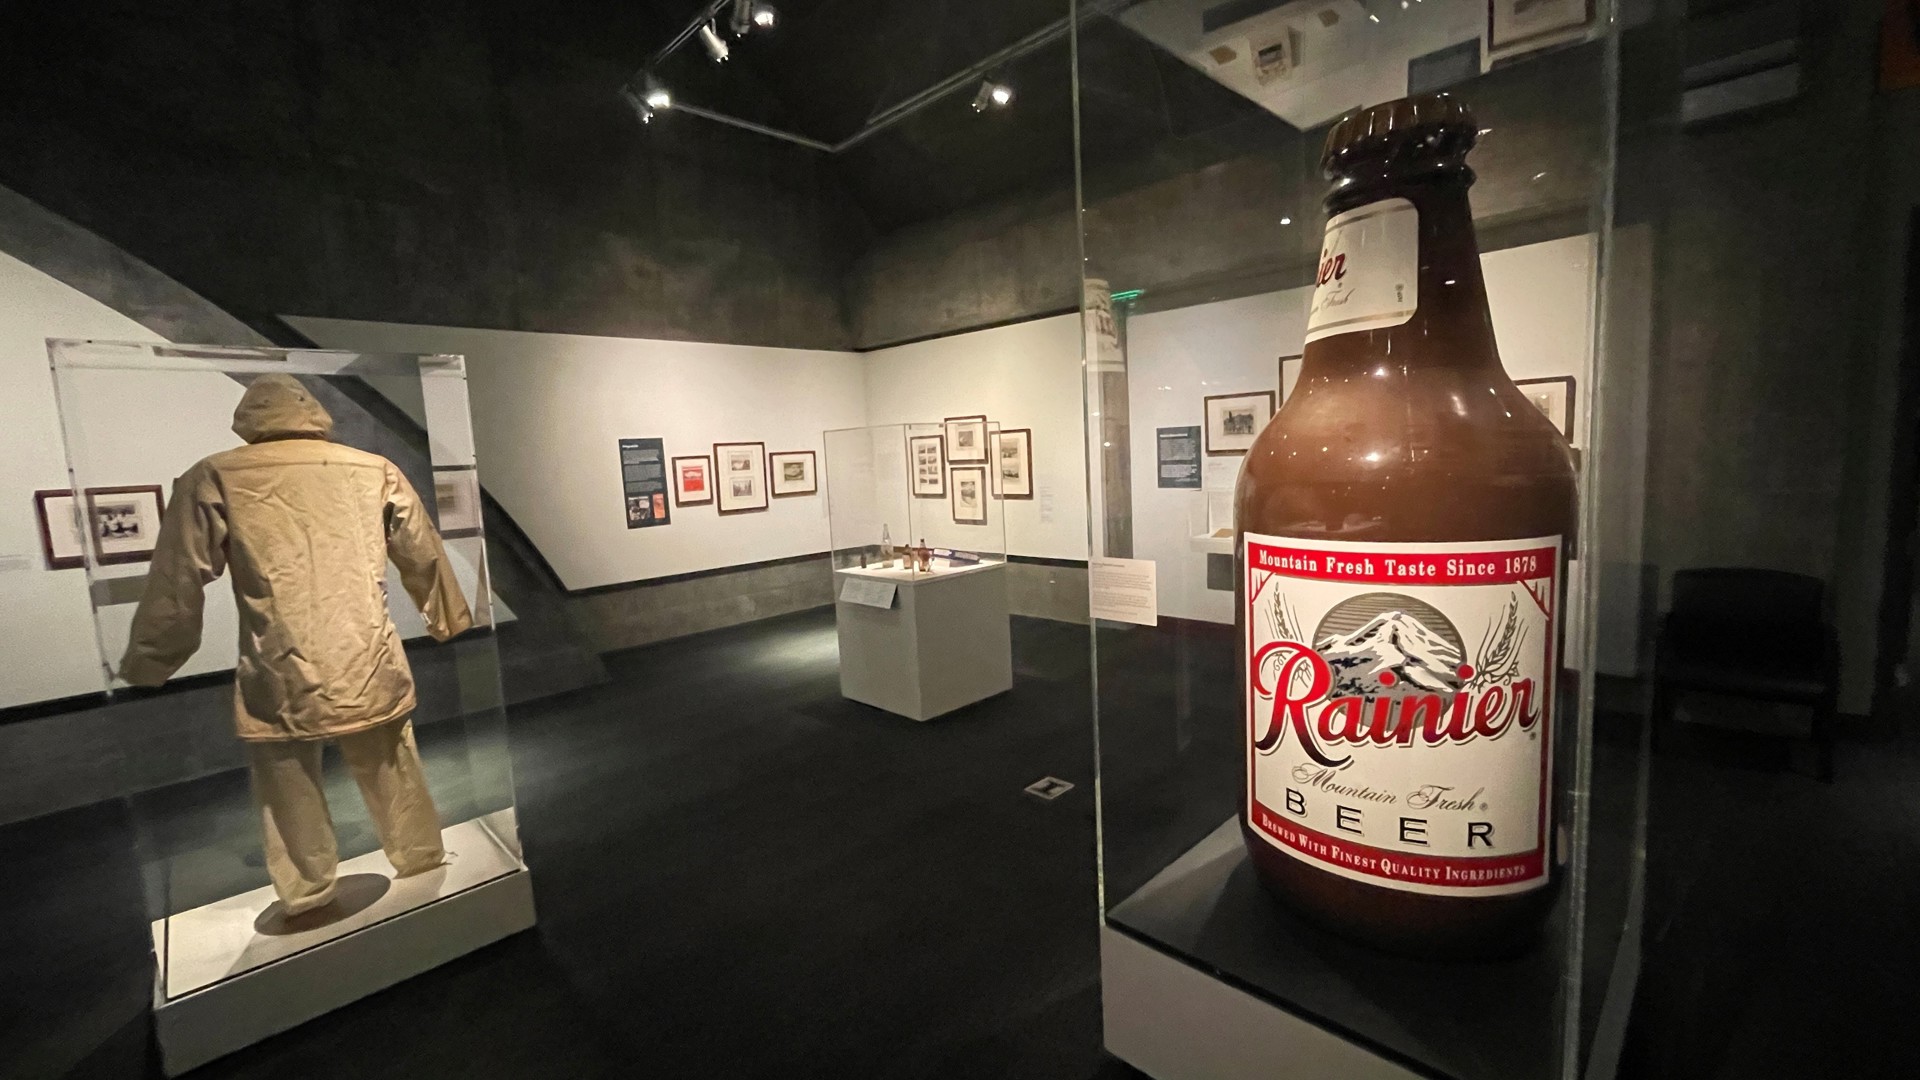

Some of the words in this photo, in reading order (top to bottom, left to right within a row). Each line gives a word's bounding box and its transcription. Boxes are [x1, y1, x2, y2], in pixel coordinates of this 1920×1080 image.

[1259, 549, 1317, 571] Mountain
[1326, 556, 1374, 575] Fresh
[1384, 559, 1436, 576] Taste
[1447, 558, 1495, 576] Since
[1505, 555, 1536, 574] 1878
[1254, 641, 1538, 767] Rainier
[1291, 762, 1397, 805] Mountain
[1406, 784, 1485, 811] Fresh
[1286, 787, 1494, 848] BEER
